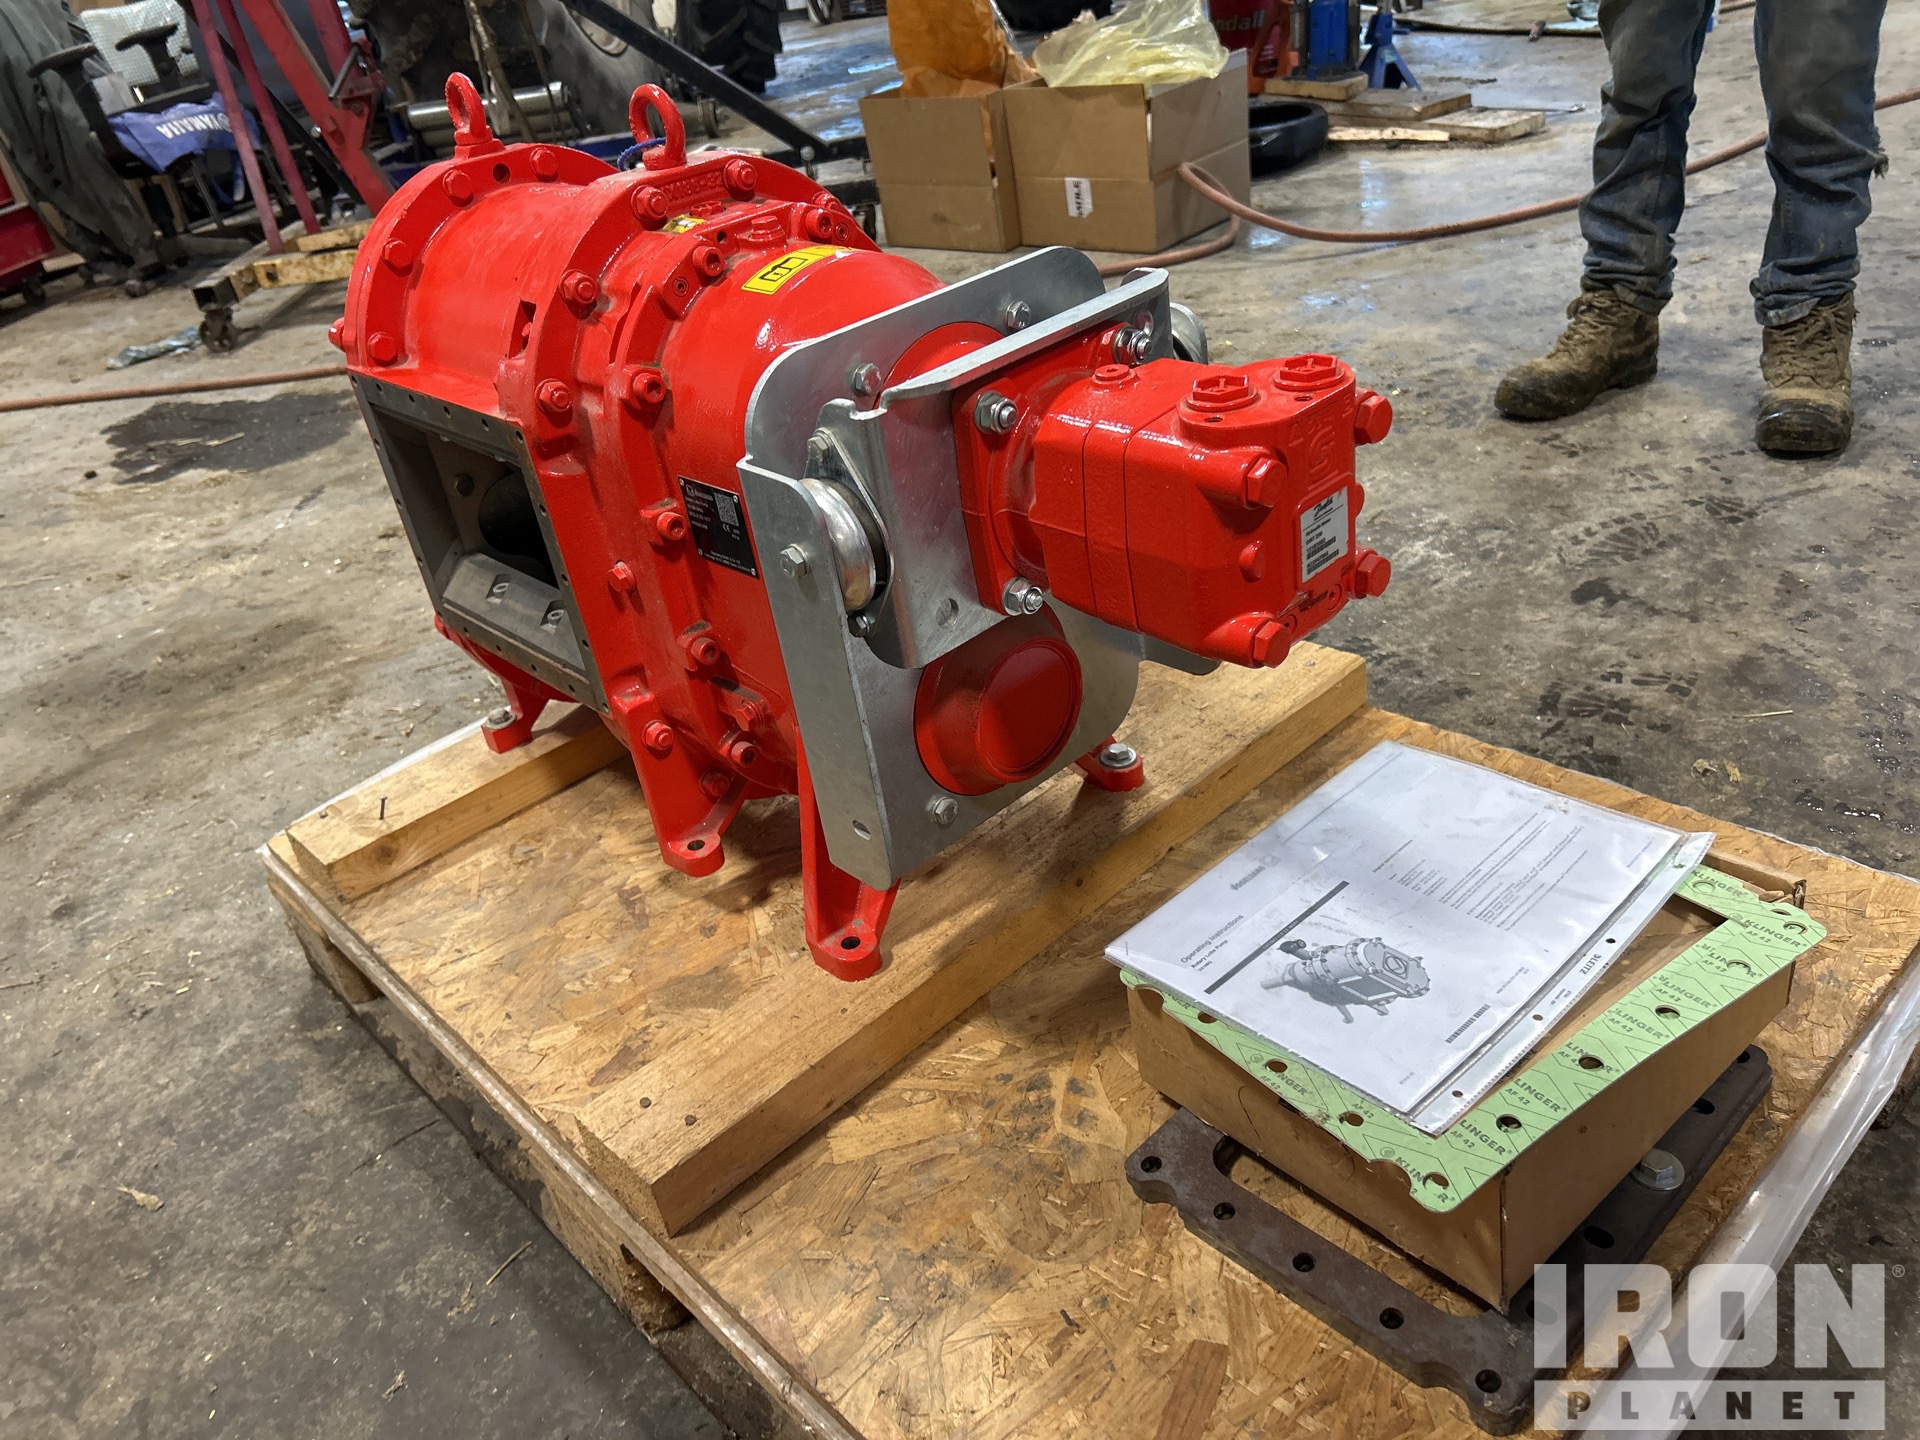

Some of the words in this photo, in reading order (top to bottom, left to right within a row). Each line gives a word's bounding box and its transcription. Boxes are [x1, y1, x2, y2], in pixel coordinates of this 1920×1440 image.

[156, 114, 223, 139] YAMAHA
[1180, 940, 1212, 963] Operating
[1209, 914, 1244, 941] Instructions
[1744, 919, 1801, 948] KLINGER
[1614, 1010, 1663, 1040] LINGER
[1505, 1088, 1518, 1096] AF
[1518, 1096, 1531, 1106] 42
[1513, 1078, 1561, 1113] LINGER
[1450, 1130, 1463, 1139] AF
[1463, 1138, 1475, 1149] 42
[1459, 1119, 1506, 1156] LINGER
[1395, 1156, 1449, 1203] KLINR
